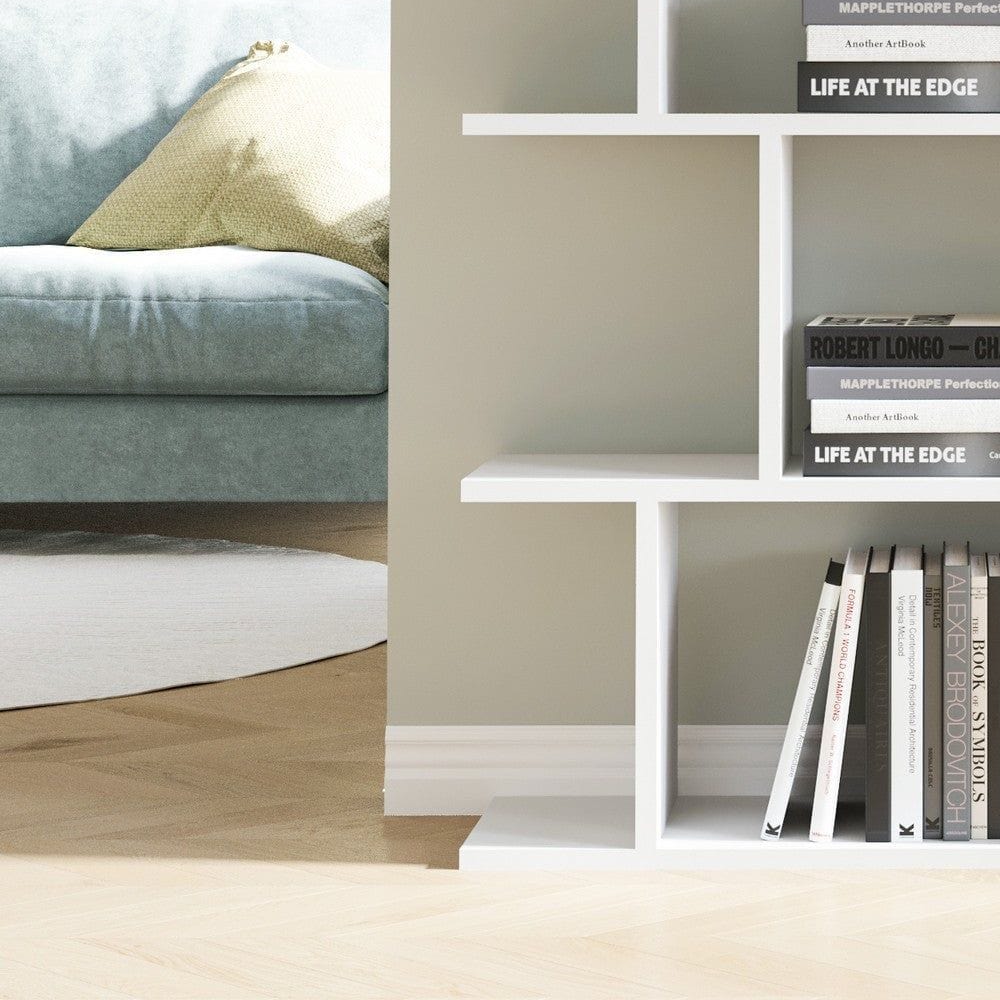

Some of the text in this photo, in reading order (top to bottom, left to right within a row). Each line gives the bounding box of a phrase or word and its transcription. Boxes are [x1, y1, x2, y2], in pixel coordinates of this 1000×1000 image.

[839, 2, 951, 14] MAPPLETHORPE
[845, 39, 926, 48] Another ArtBook
[810, 78, 978, 96] LIFE AT THE EDGE
[810, 336, 880, 360] ROBERT
[885, 336, 943, 360] LONGO
[840, 379, 942, 390] MAPPLETHORPE
[846, 413, 919, 421] Another ArtBook
[814, 446, 966, 463] LIFE AT THE EDGE
[844, 588, 856, 629] FORMULA
[909, 594, 917, 617] Detail
[946, 572, 967, 663] ALEXEY
[840, 639, 850, 669] WORLD
[973, 640, 986, 691] BOOK
[946, 671, 967, 822] BRODOVITCH
[972, 711, 986, 803] SYMBOLS
[765, 822, 780, 836] K
[899, 823, 914, 836] K
[926, 816, 940, 830] K
